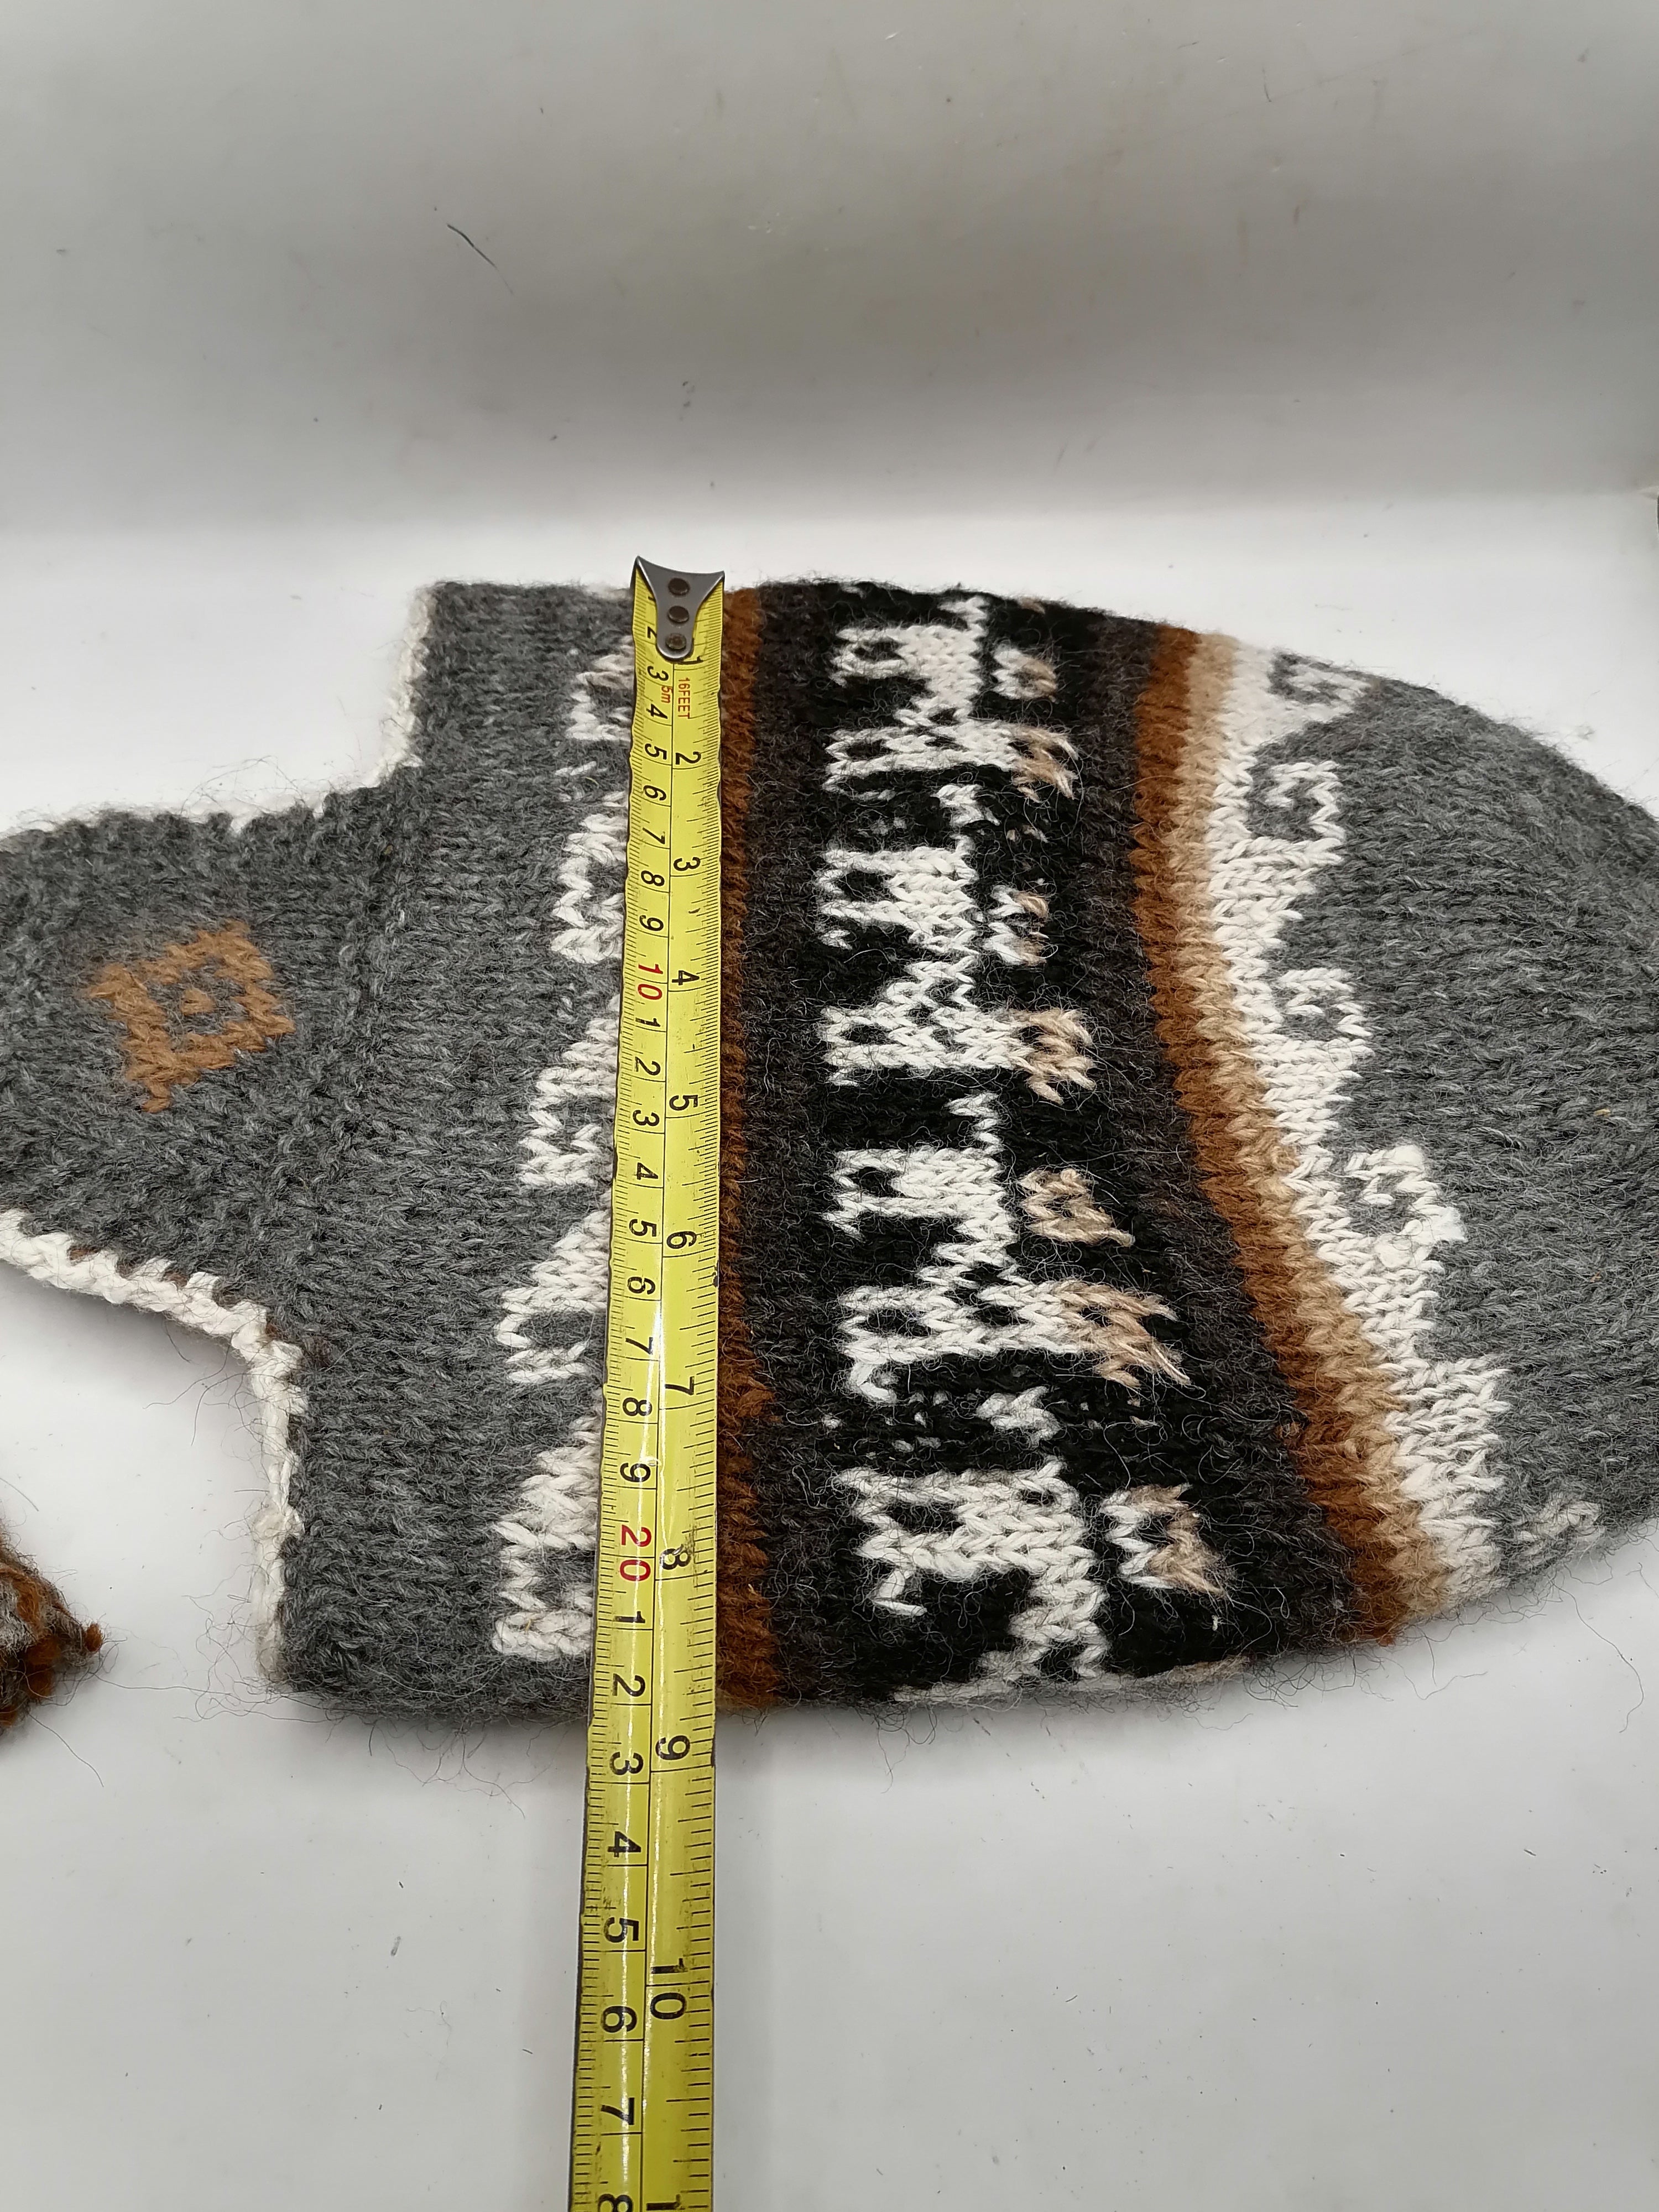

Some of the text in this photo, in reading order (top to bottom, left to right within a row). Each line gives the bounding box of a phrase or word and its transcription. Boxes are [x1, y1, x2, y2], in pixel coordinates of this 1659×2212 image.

[647, 666, 669, 681] 3
[661, 685, 674, 704] 5m
[677, 677, 691, 719] 16FEET
[646, 703, 668, 719] 4
[645, 744, 667, 760] 5
[675, 752, 701, 765] 2
[643, 785, 666, 801] 6
[643, 827, 665, 844] 7
[673, 857, 701, 871] 3
[640, 870, 665, 887] 8
[639, 915, 664, 931] 9
[638, 964, 663, 1000] 10
[672, 970, 700, 985] 4
[635, 1018, 660, 1027] 1
[634, 1056, 661, 1076] 2
[669, 1094, 698, 1110] 5
[633, 1110, 660, 1126] 3
[635, 1162, 659, 1180] 4
[629, 1219, 657, 1237] 5
[666, 1230, 697, 1249] 6
[627, 1276, 655, 1295] 6
[625, 1337, 653, 1354] 7
[665, 1376, 695, 1395] 7
[622, 1397, 653, 1416] 8
[620, 1462, 651, 1483] 9
[619, 1525, 651, 1581] 20
[659, 1548, 691, 1570] 8
[614, 1611, 645, 1624] 1
[612, 1673, 645, 1697] 2
[655, 1735, 690, 1760] 9
[610, 1751, 643, 1776] 3
[608, 1831, 641, 1858] 4
[603, 1917, 639, 1943] 5
[650, 1958, 688, 2020] 10
[601, 2006, 637, 2032] 6
[601, 2098, 634, 2125] 7
[598, 2193, 633, 2212] 8
